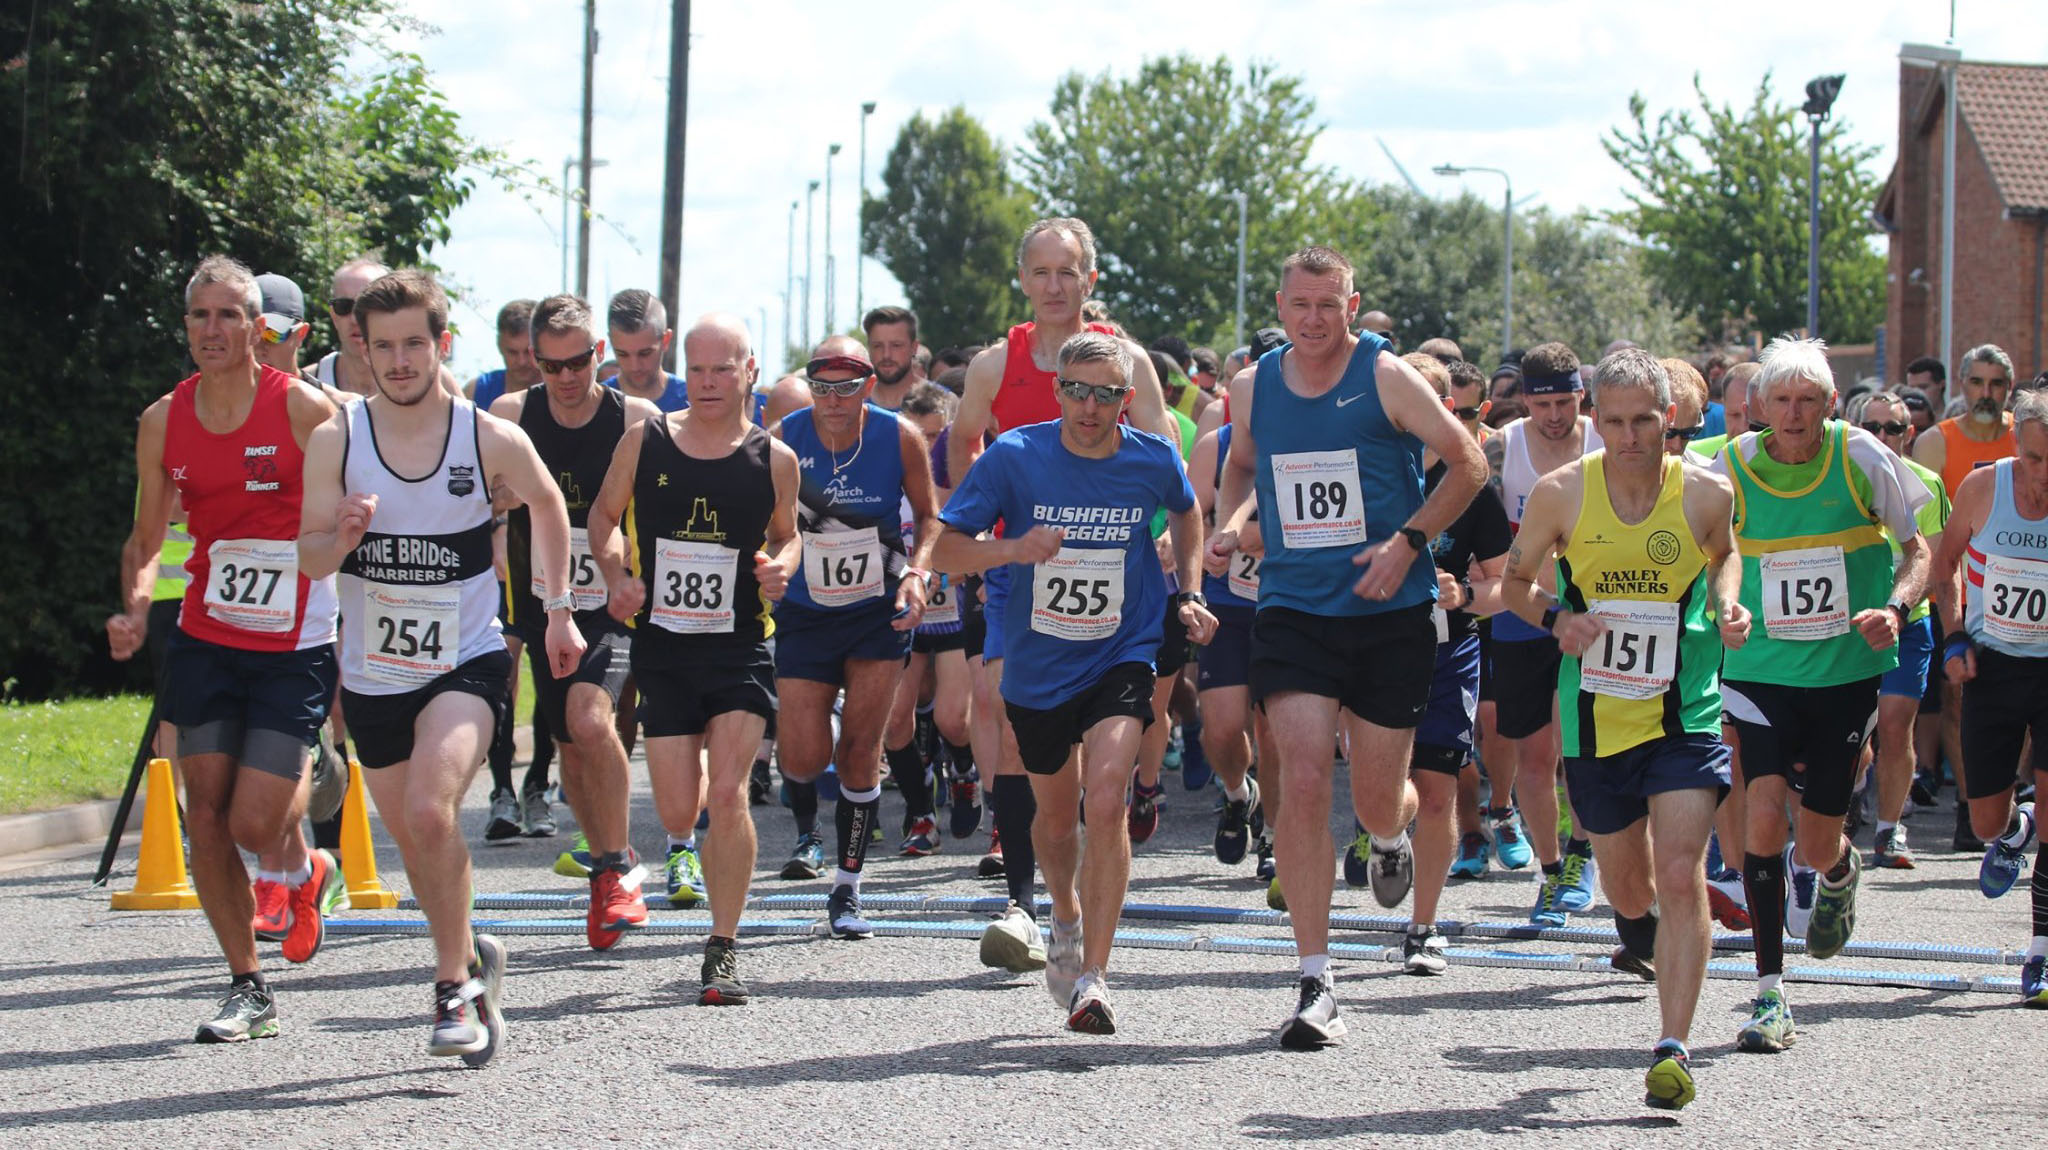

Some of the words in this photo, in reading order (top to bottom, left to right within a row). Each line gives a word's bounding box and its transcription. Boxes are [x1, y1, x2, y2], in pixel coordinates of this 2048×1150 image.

[244, 446, 278, 457] RAMSEY
[823, 486, 864, 504] March
[834, 497, 864, 505] Athletic
[1294, 481, 1348, 520] 189
[1033, 504, 1143, 523] BUSHFIELD
[356, 538, 393, 564] TYNE
[398, 538, 461, 567] BRIDGE
[219, 563, 283, 605] 327
[364, 565, 447, 581] HARRIERS
[822, 552, 869, 587] 167
[1601, 569, 1662, 581] YAXLEY
[663, 570, 723, 610] 383
[1047, 577, 1110, 616] 255
[1595, 582, 1669, 595] RUNNERS
[1780, 576, 1834, 616] 152
[1991, 583, 2047, 622] 370
[1598, 610, 1629, 619] Advance
[1629, 612, 1677, 622] Performance
[377, 616, 443, 660] 254
[1602, 629, 1657, 674] 151
